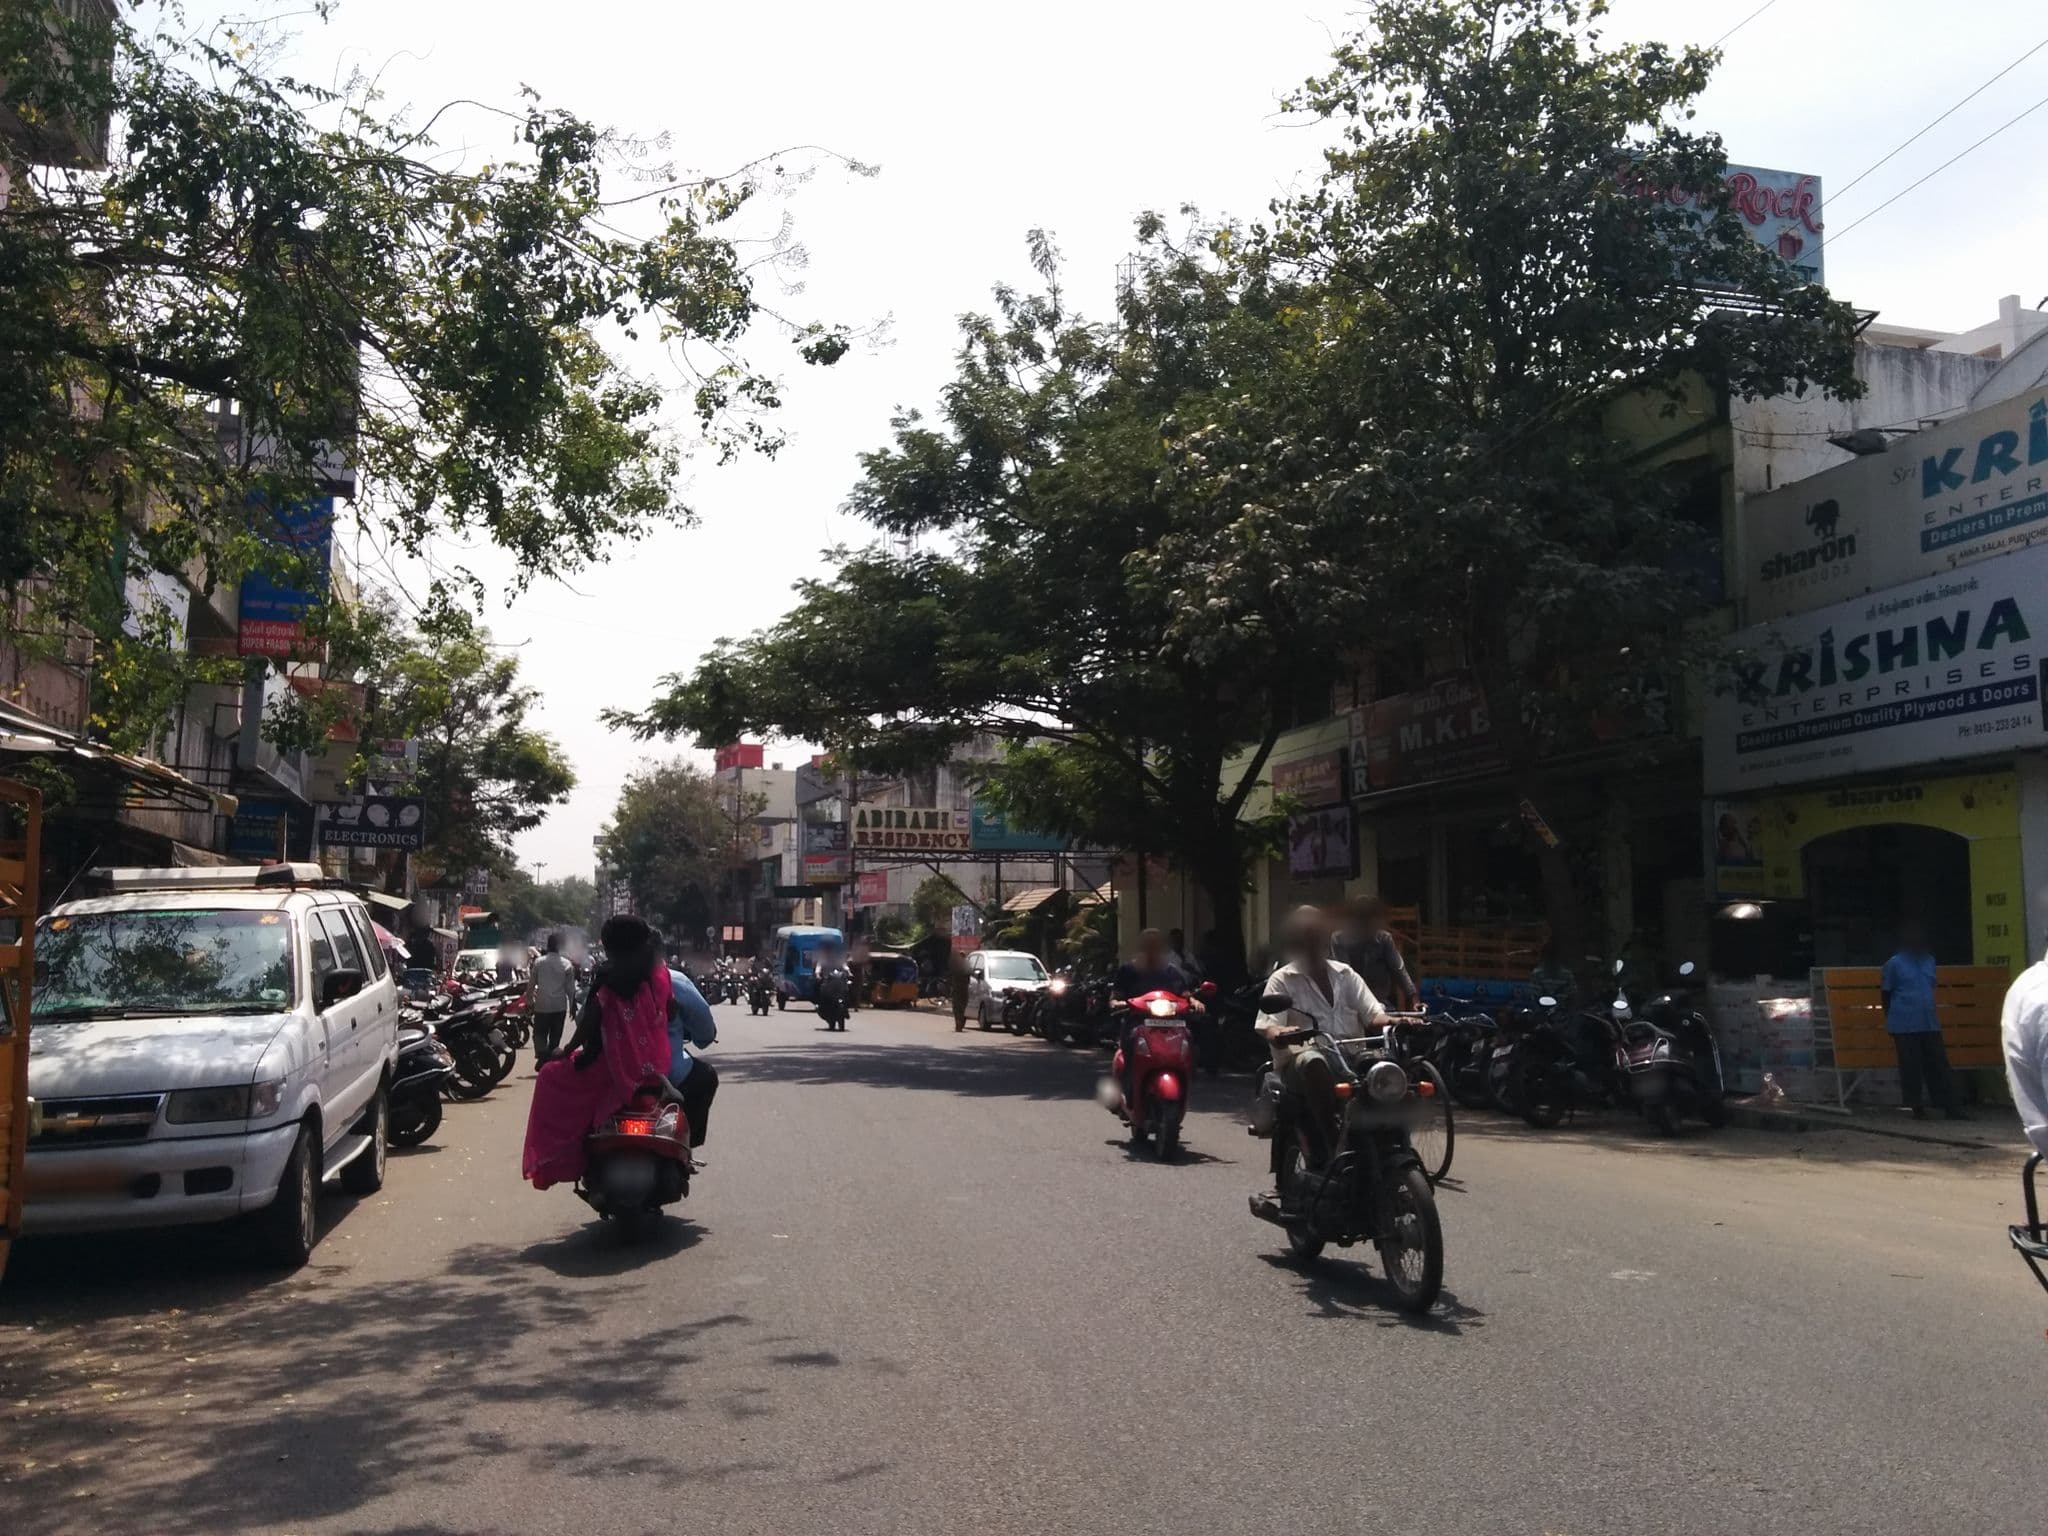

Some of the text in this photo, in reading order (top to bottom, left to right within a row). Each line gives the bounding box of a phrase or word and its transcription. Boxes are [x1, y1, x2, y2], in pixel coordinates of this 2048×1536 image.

[1727, 172, 1825, 233] Rock
[1930, 518, 1986, 545] Dealers
[1759, 533, 1857, 582] sharon
[1743, 653, 2031, 727] ENTERPRISES
[1740, 731, 1783, 747] Dealers
[1799, 718, 1849, 738] Premium
[1853, 706, 1904, 727] Quality
[1904, 692, 1964, 718] Plywood
[1968, 693, 1977, 705] &
[1982, 683, 2030, 702] Doors
[1349, 711, 1370, 794] BAR
[324, 828, 419, 846] ELECTRONICS
[855, 830, 970, 849] RESIDENCY
[856, 808, 950, 831] ABIRAMI
